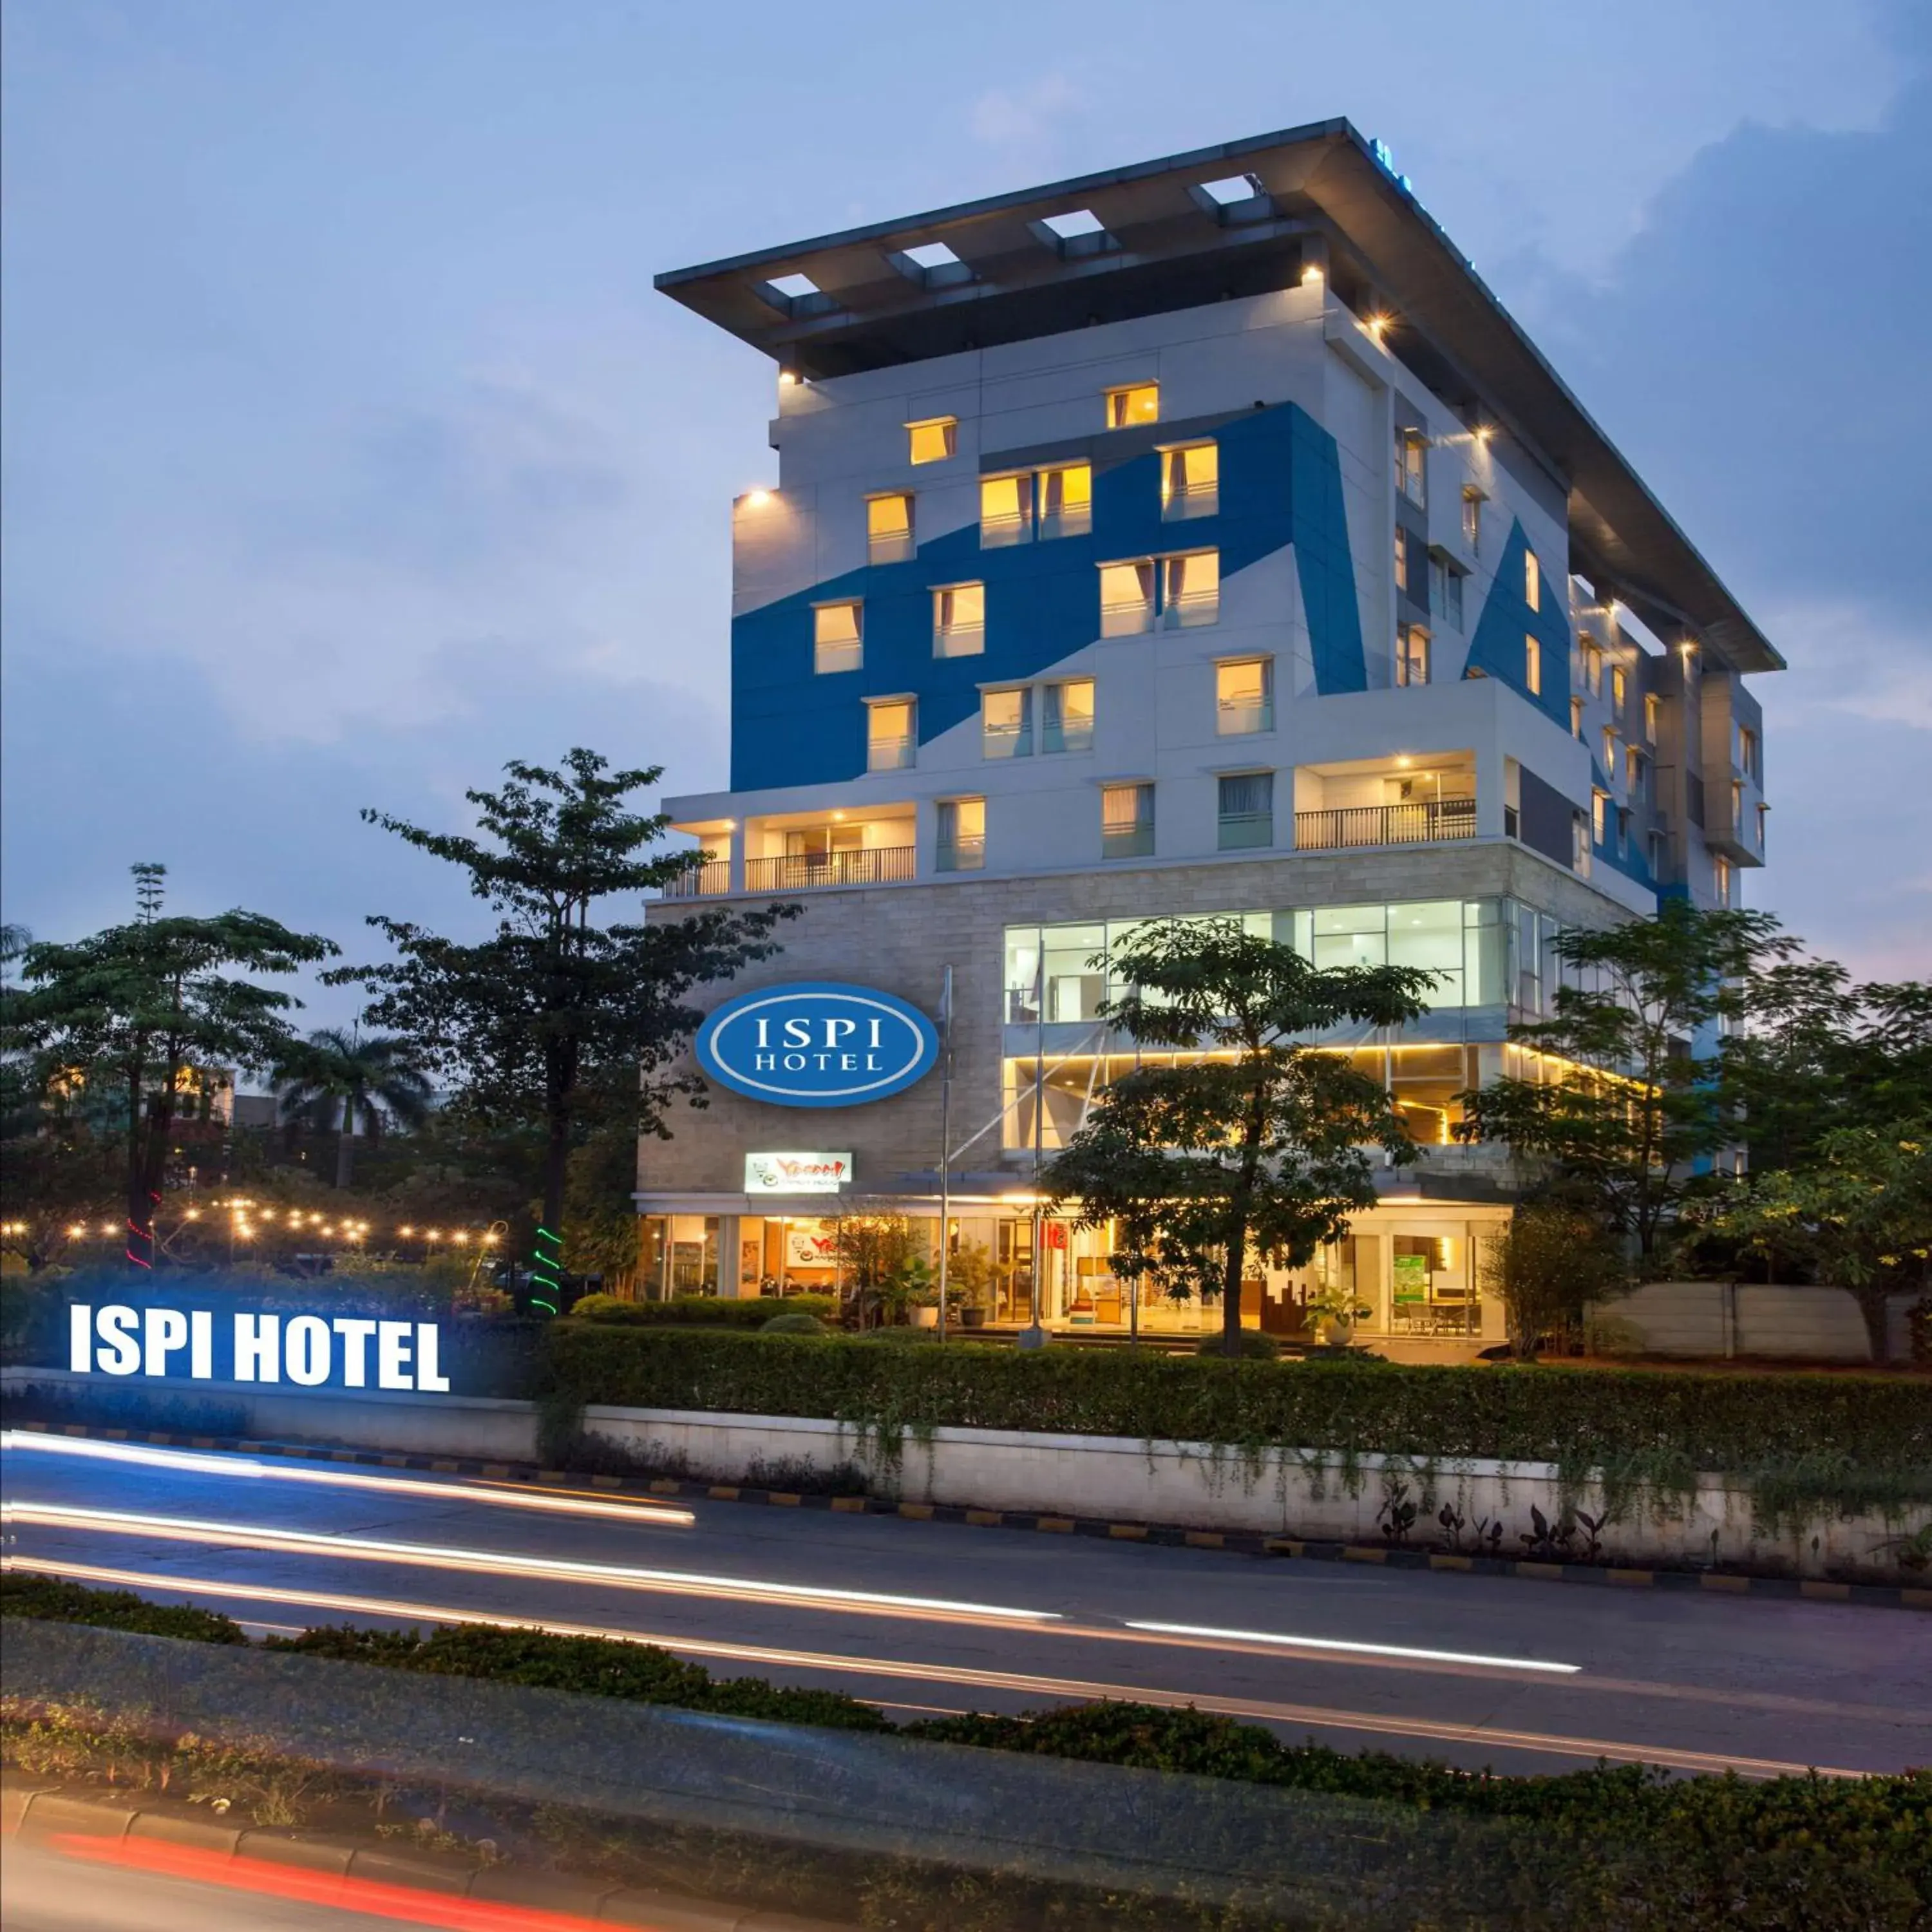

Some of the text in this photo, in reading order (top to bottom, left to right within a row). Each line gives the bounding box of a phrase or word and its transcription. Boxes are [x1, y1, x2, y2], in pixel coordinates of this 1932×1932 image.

[755, 1018, 884, 1048] ISPI
[755, 1054, 884, 1071] HOTEL
[71, 1304, 450, 1392] ISPI HOTEL
